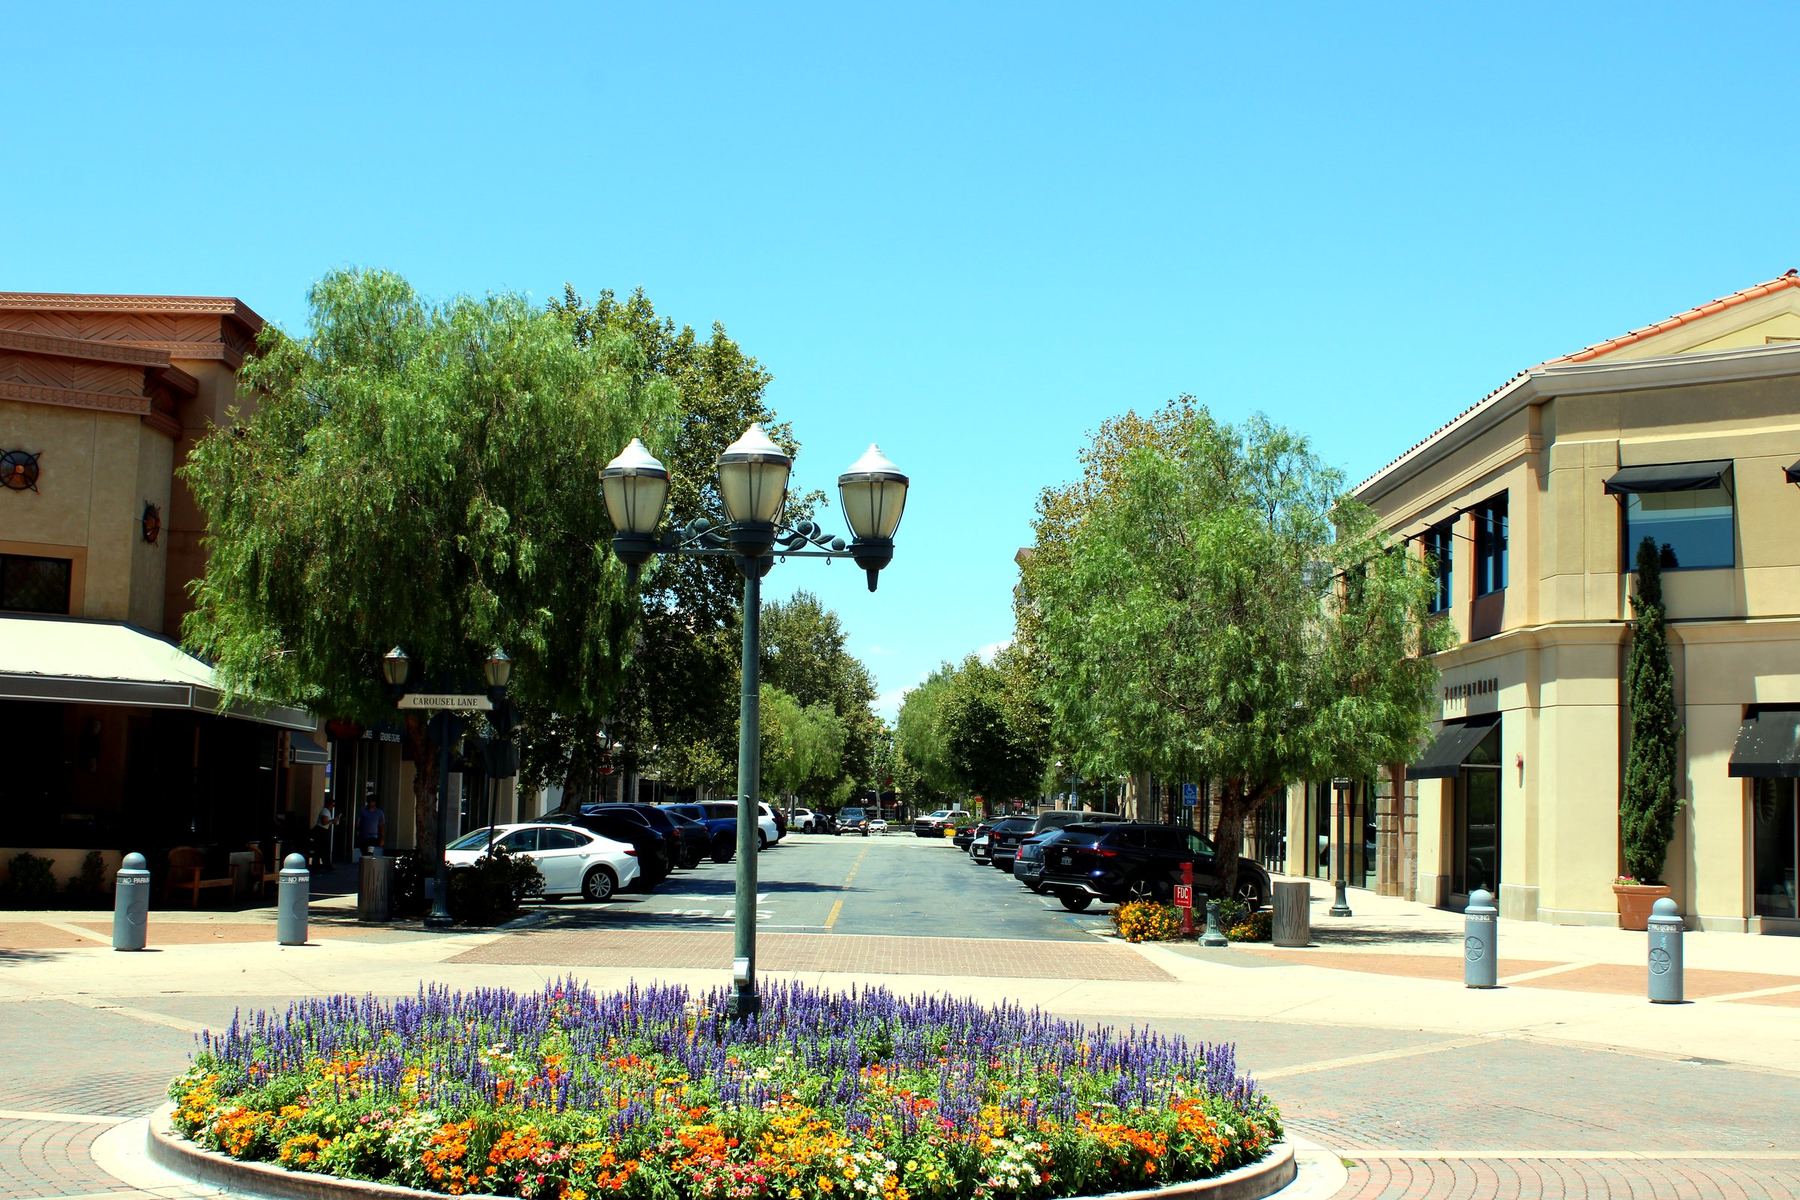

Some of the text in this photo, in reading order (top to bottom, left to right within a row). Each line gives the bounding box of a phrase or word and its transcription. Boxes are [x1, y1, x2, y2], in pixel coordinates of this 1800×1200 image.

[413, 697, 478, 707] CAROUSEL LANE
[1177, 886, 1189, 899] FDC
